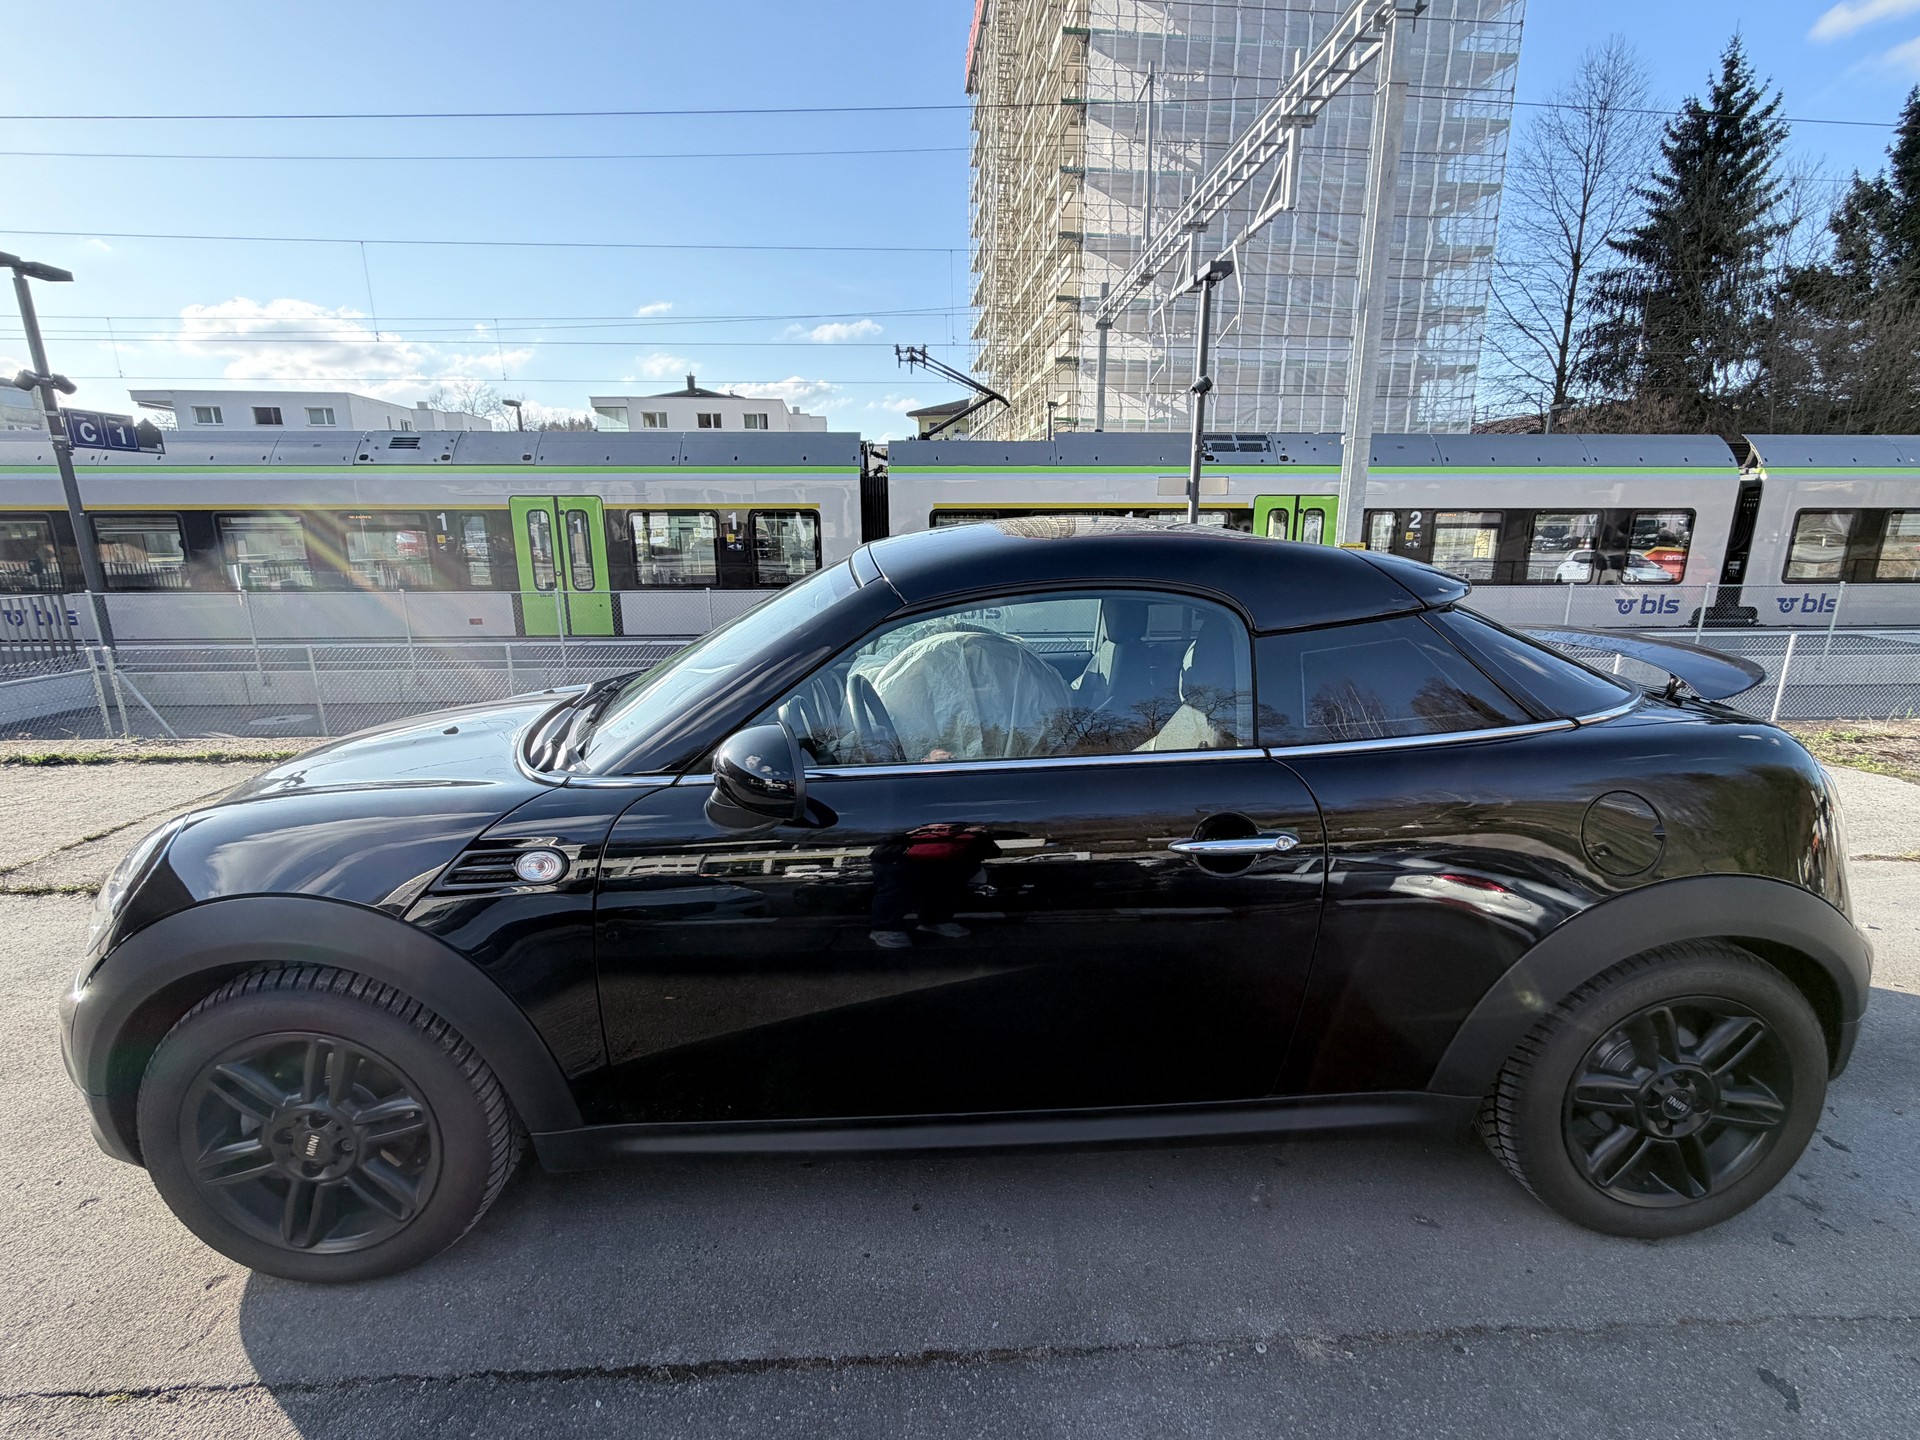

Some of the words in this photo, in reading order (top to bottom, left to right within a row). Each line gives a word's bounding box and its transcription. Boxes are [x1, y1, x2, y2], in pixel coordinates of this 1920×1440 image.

[79, 422, 97, 442] C
[117, 426, 127, 444] 1
[437, 512, 448, 531] 1
[573, 518, 582, 534] 1
[727, 511, 737, 530] 1
[1409, 511, 1422, 528] 2
[1641, 594, 1680, 614] bls
[1800, 593, 1837, 613] bls
[33, 604, 79, 626] bls
[1667, 1095, 1688, 1111] MINI
[306, 1135, 320, 1156] MINI
